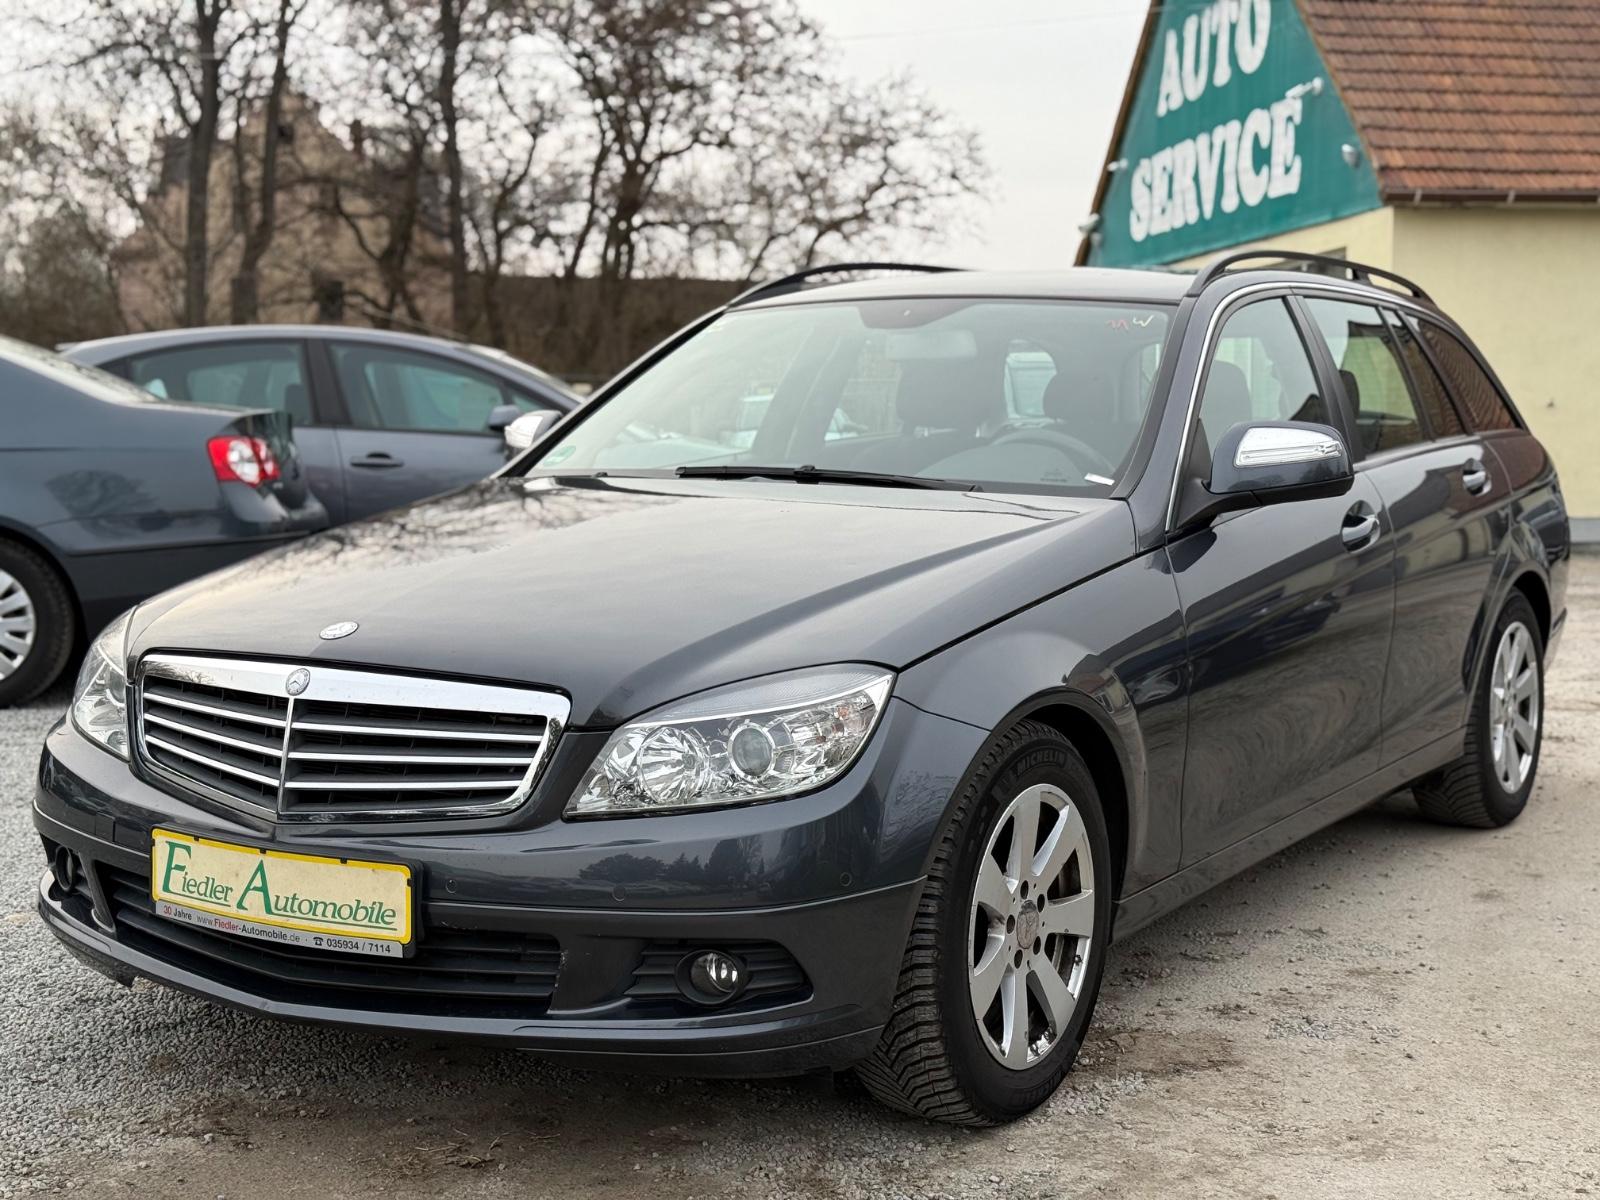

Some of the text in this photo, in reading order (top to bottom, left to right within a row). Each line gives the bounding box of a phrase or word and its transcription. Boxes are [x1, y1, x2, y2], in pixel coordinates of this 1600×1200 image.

[1156, 0, 1271, 117] AUTO
[1129, 98, 1303, 242] SERVICE
[161, 840, 397, 926] Fiedler Automobile
[163, 904, 172, 916] 30
[173, 908, 192, 921] Jahre
[197, 914, 301, 943] www.Fiedler-Automobile.de
[326, 938, 359, 951] 035934
[368, 942, 391, 954] 7114
